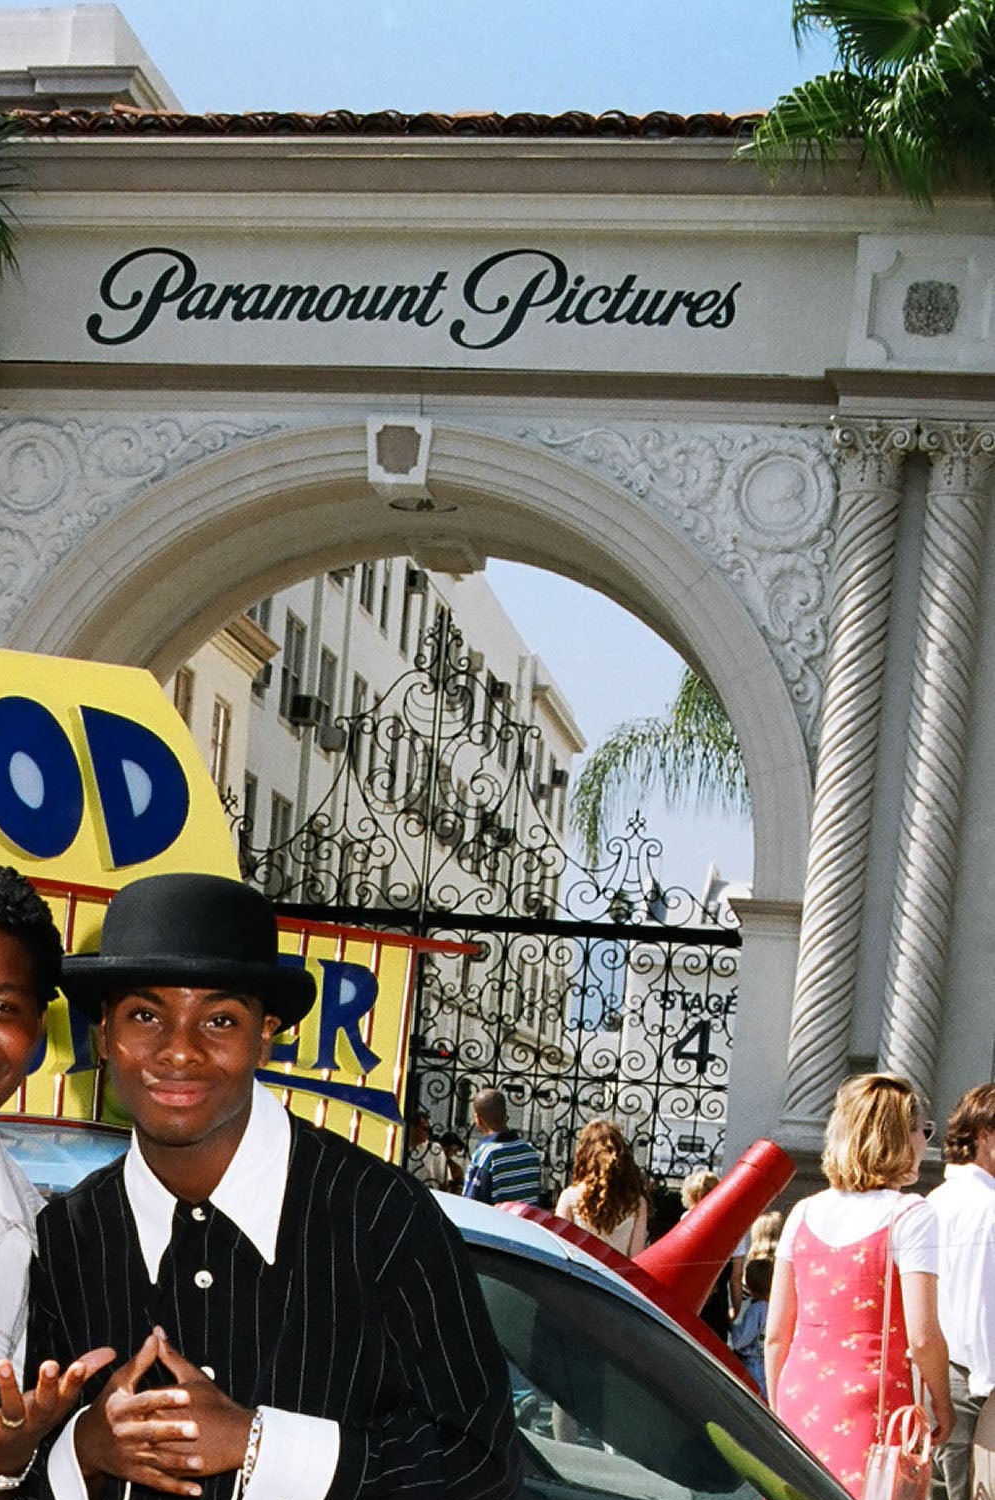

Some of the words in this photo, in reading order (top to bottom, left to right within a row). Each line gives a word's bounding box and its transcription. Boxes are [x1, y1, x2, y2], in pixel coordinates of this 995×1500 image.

[86, 247, 448, 345] Paramount
[450, 248, 743, 350] Pictures
[660, 991, 737, 1015] STAGE
[672, 1020, 715, 1073] 4
